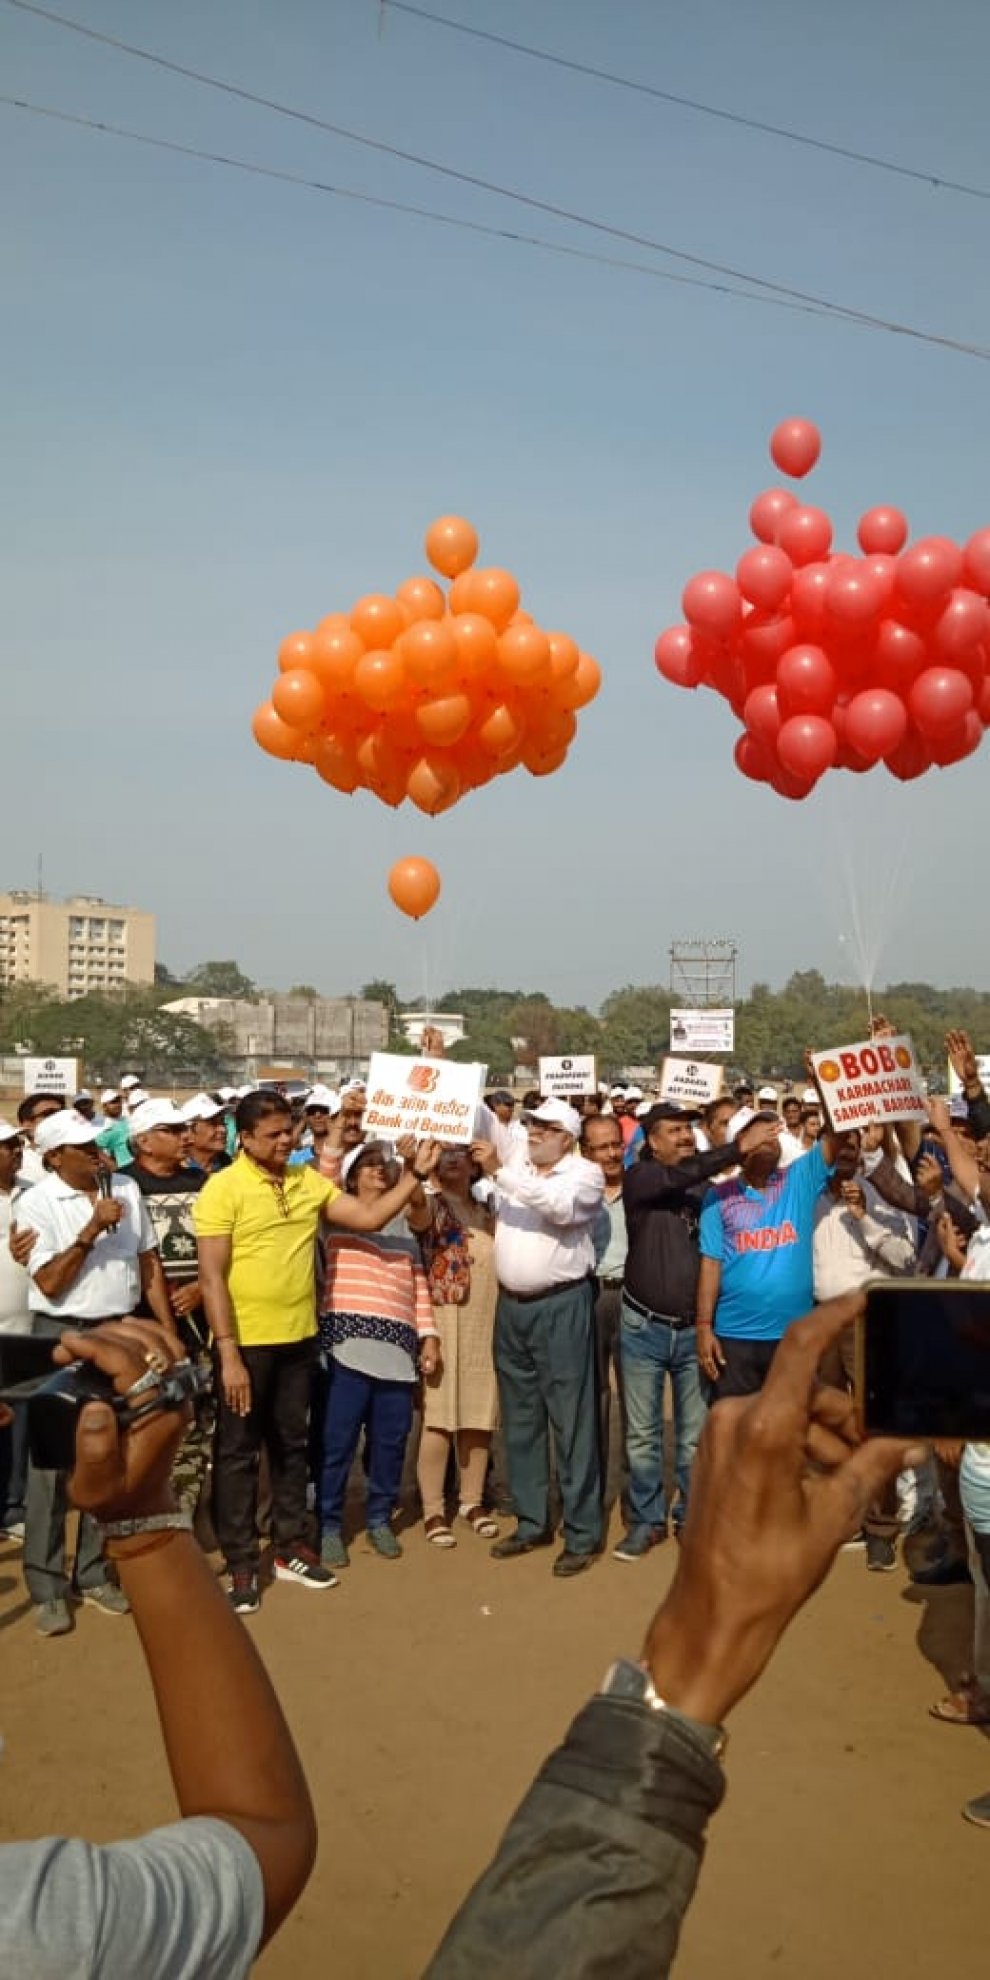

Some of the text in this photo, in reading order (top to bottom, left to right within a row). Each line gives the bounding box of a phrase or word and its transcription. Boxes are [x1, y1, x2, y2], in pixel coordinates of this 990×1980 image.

[839, 1045, 895, 1079] BOB
[837, 1078, 912, 1102] KARMACHARI
[834, 1096, 924, 1122] SANGH, BARODA
[367, 1110, 469, 1136] Bank of Baroda
[736, 1221, 797, 1254] INDIA
